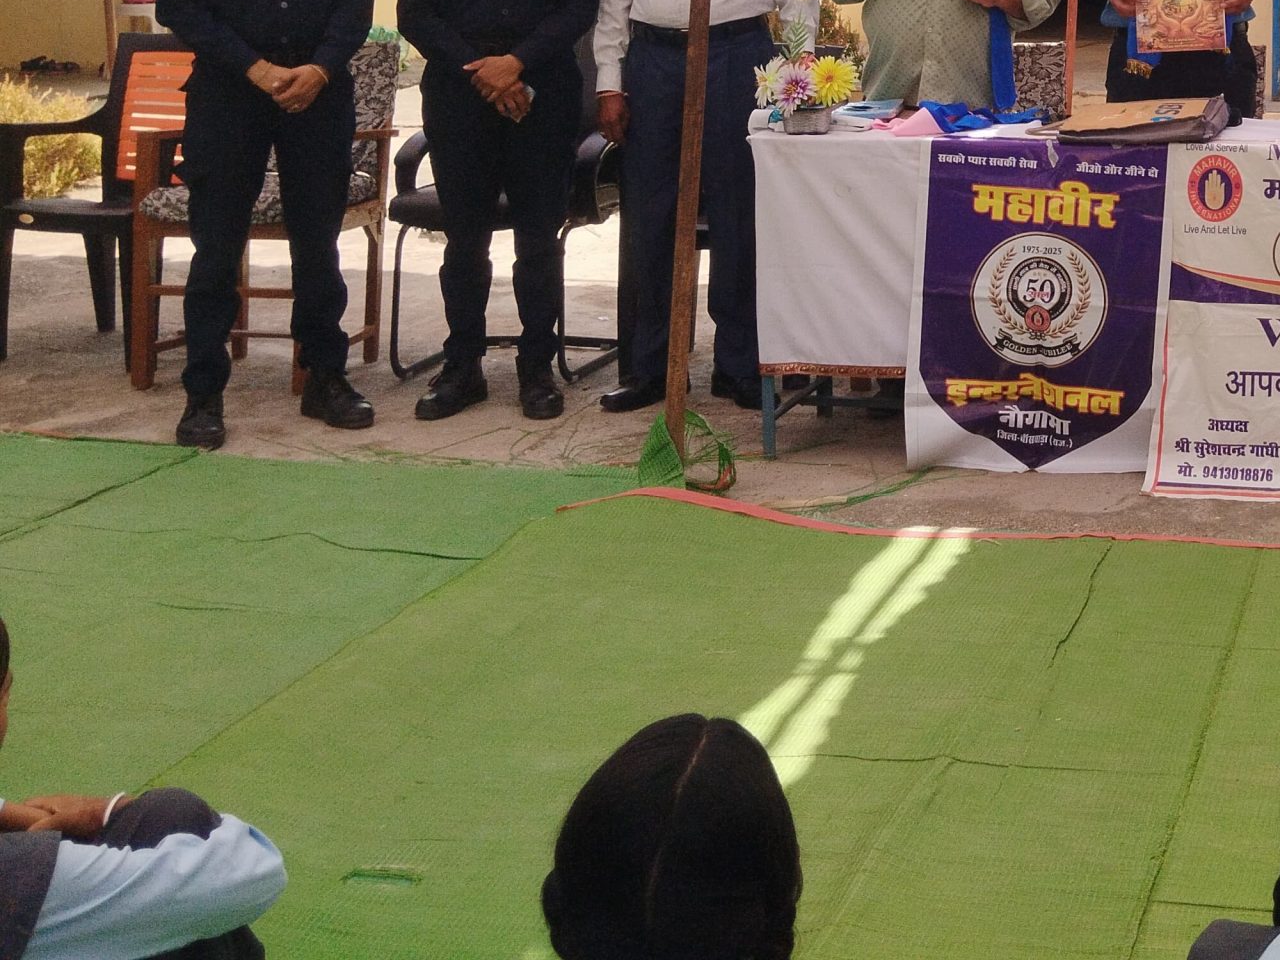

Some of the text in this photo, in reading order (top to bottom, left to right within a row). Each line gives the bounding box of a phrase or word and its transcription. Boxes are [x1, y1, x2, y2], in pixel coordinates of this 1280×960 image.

[1215, 144, 1238, 153] Serve
[1238, 145, 1249, 153] All
[1019, 157, 1038, 169] सेवा
[1193, 157, 1238, 178] MAHAVIR
[971, 180, 1120, 230] महावीर
[1184, 224, 1247, 236] Live And Let Live
[1022, 245, 1063, 256] 1975-2025
[1022, 278, 1056, 304] 50
[1003, 339, 1038, 354] GOLDEN
[945, 372, 1125, 416] इन्टरनेशनल
[1208, 418, 1249, 433] अध्यक्ष
[1174, 437, 1280, 459] श्री सुरेशचन्द्र गांधी
[1177, 461, 1274, 482] मो. 9413018876
